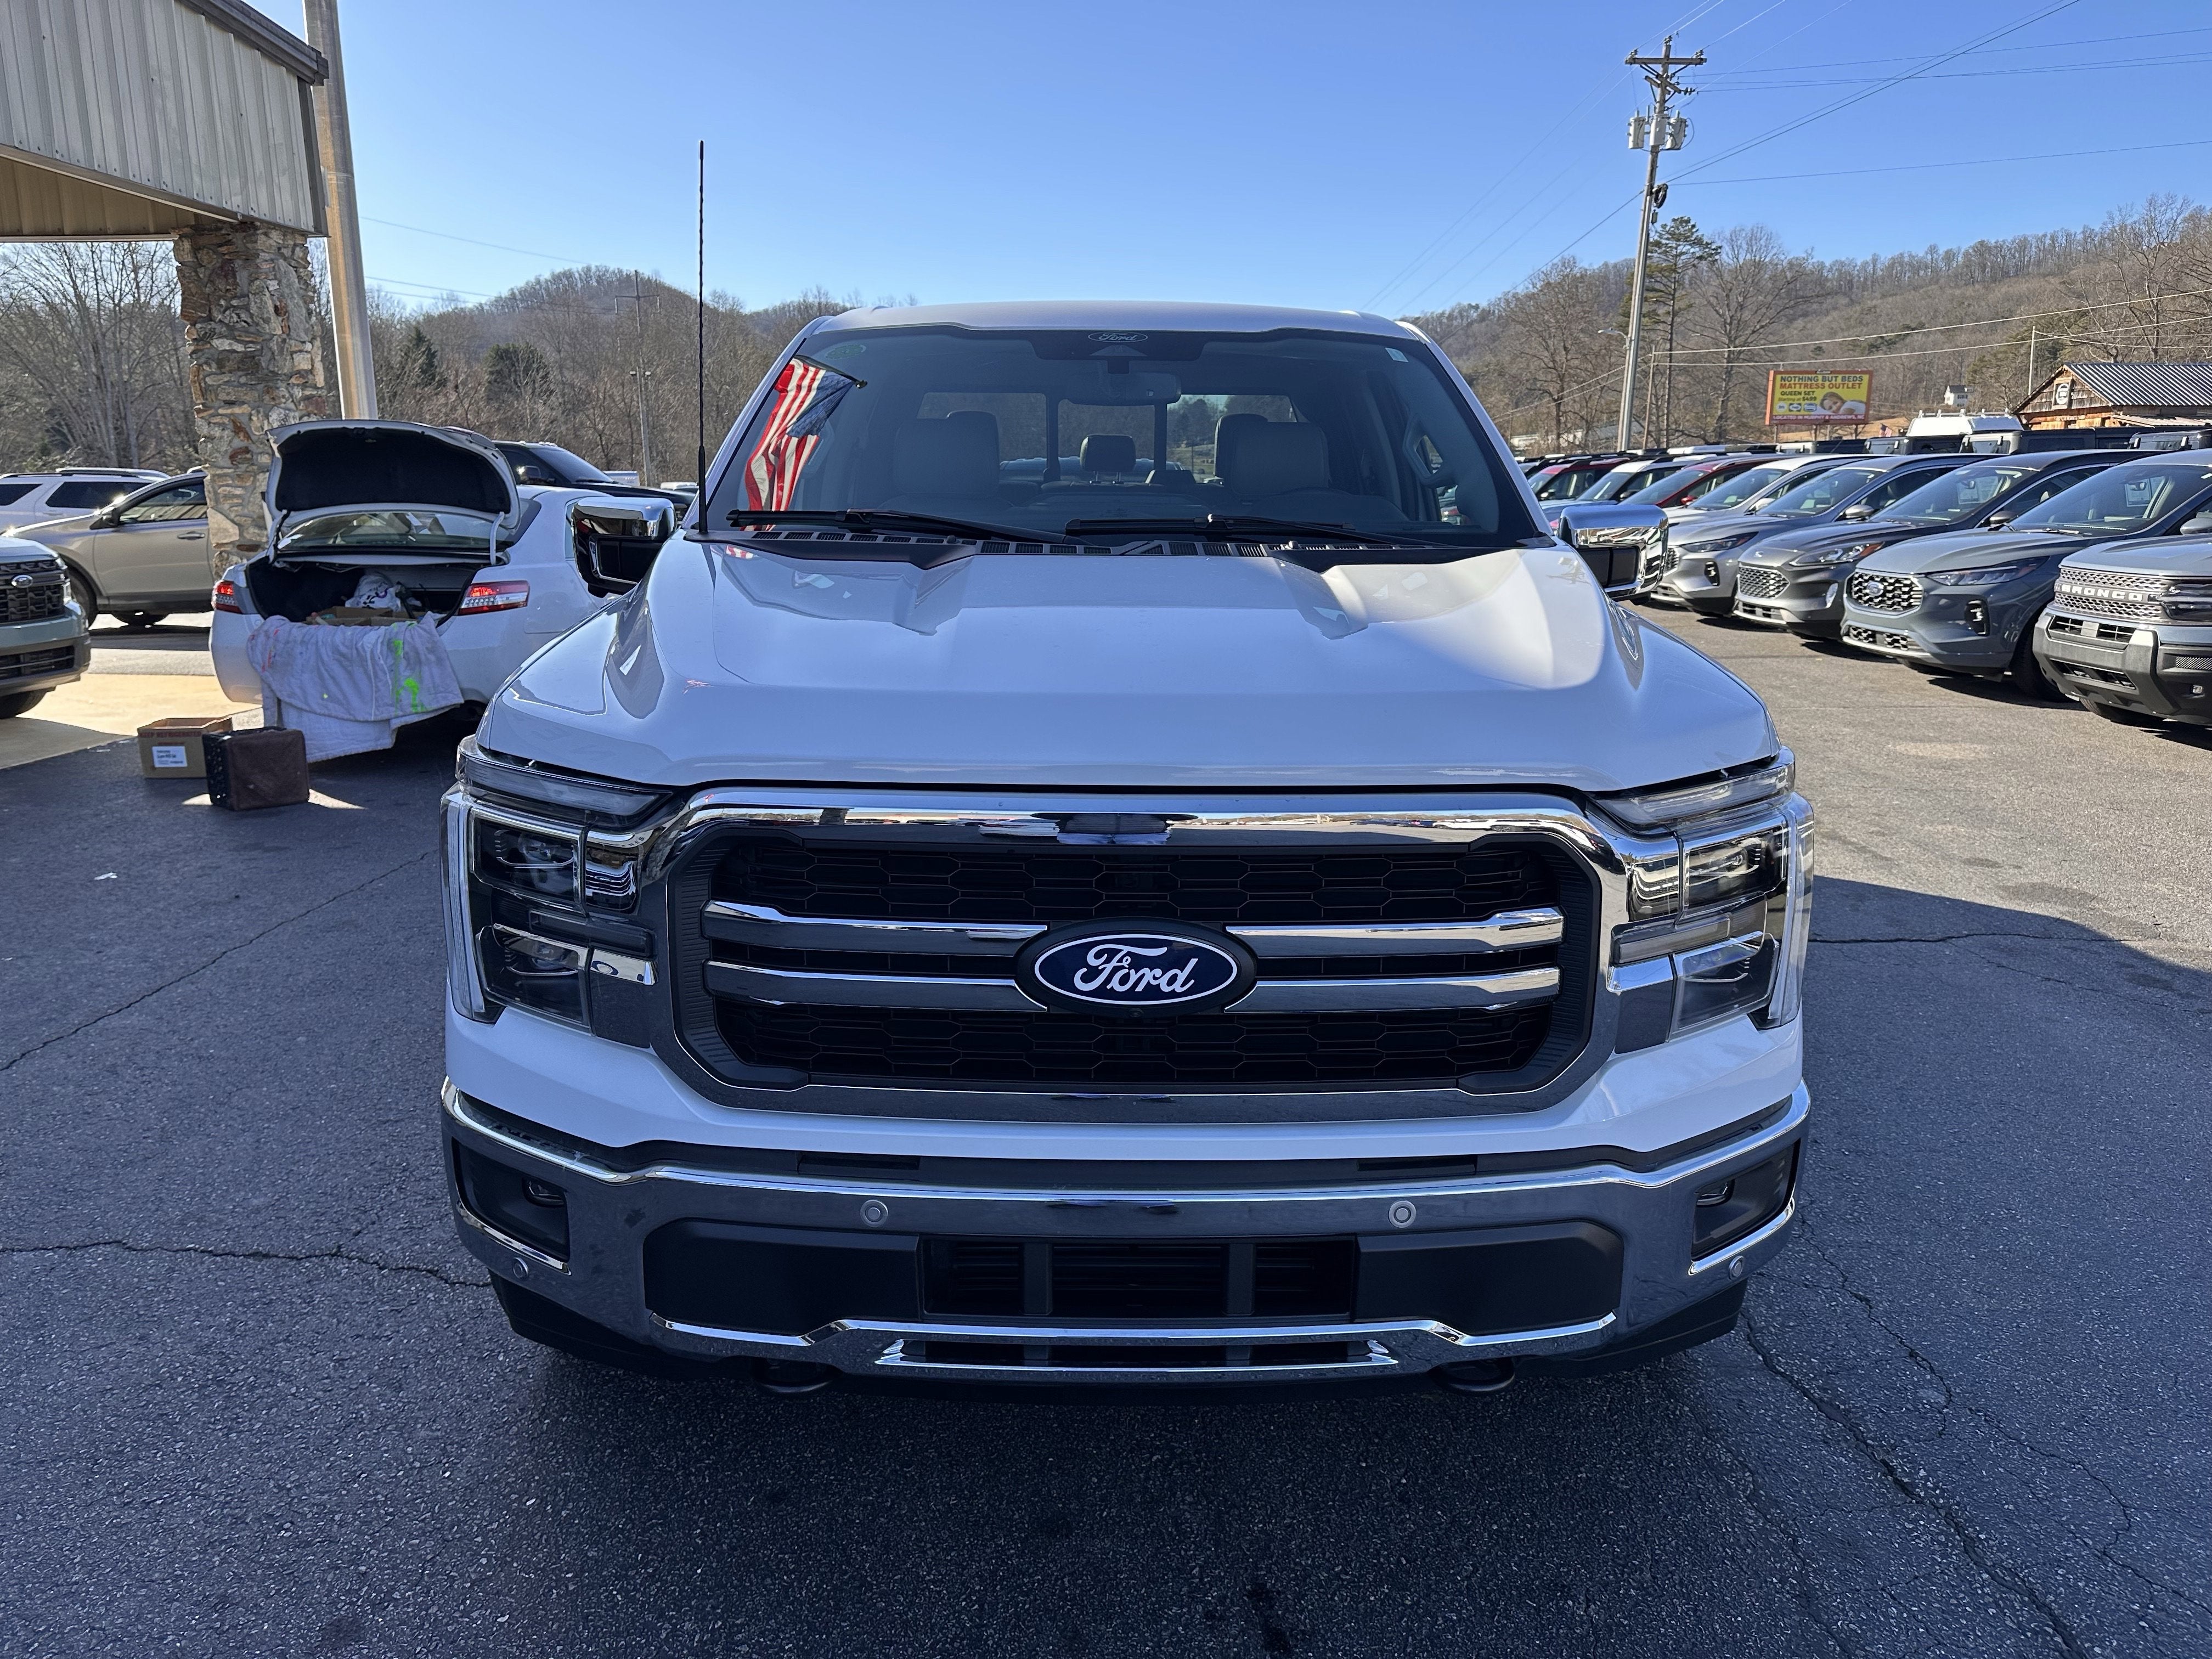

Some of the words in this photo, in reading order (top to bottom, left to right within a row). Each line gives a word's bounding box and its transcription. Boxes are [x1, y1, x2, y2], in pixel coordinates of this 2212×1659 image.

[1098, 332, 1138, 341] Ford
[2061, 584, 2143, 601] BRONCO
[1074, 944, 1199, 992] Ford
